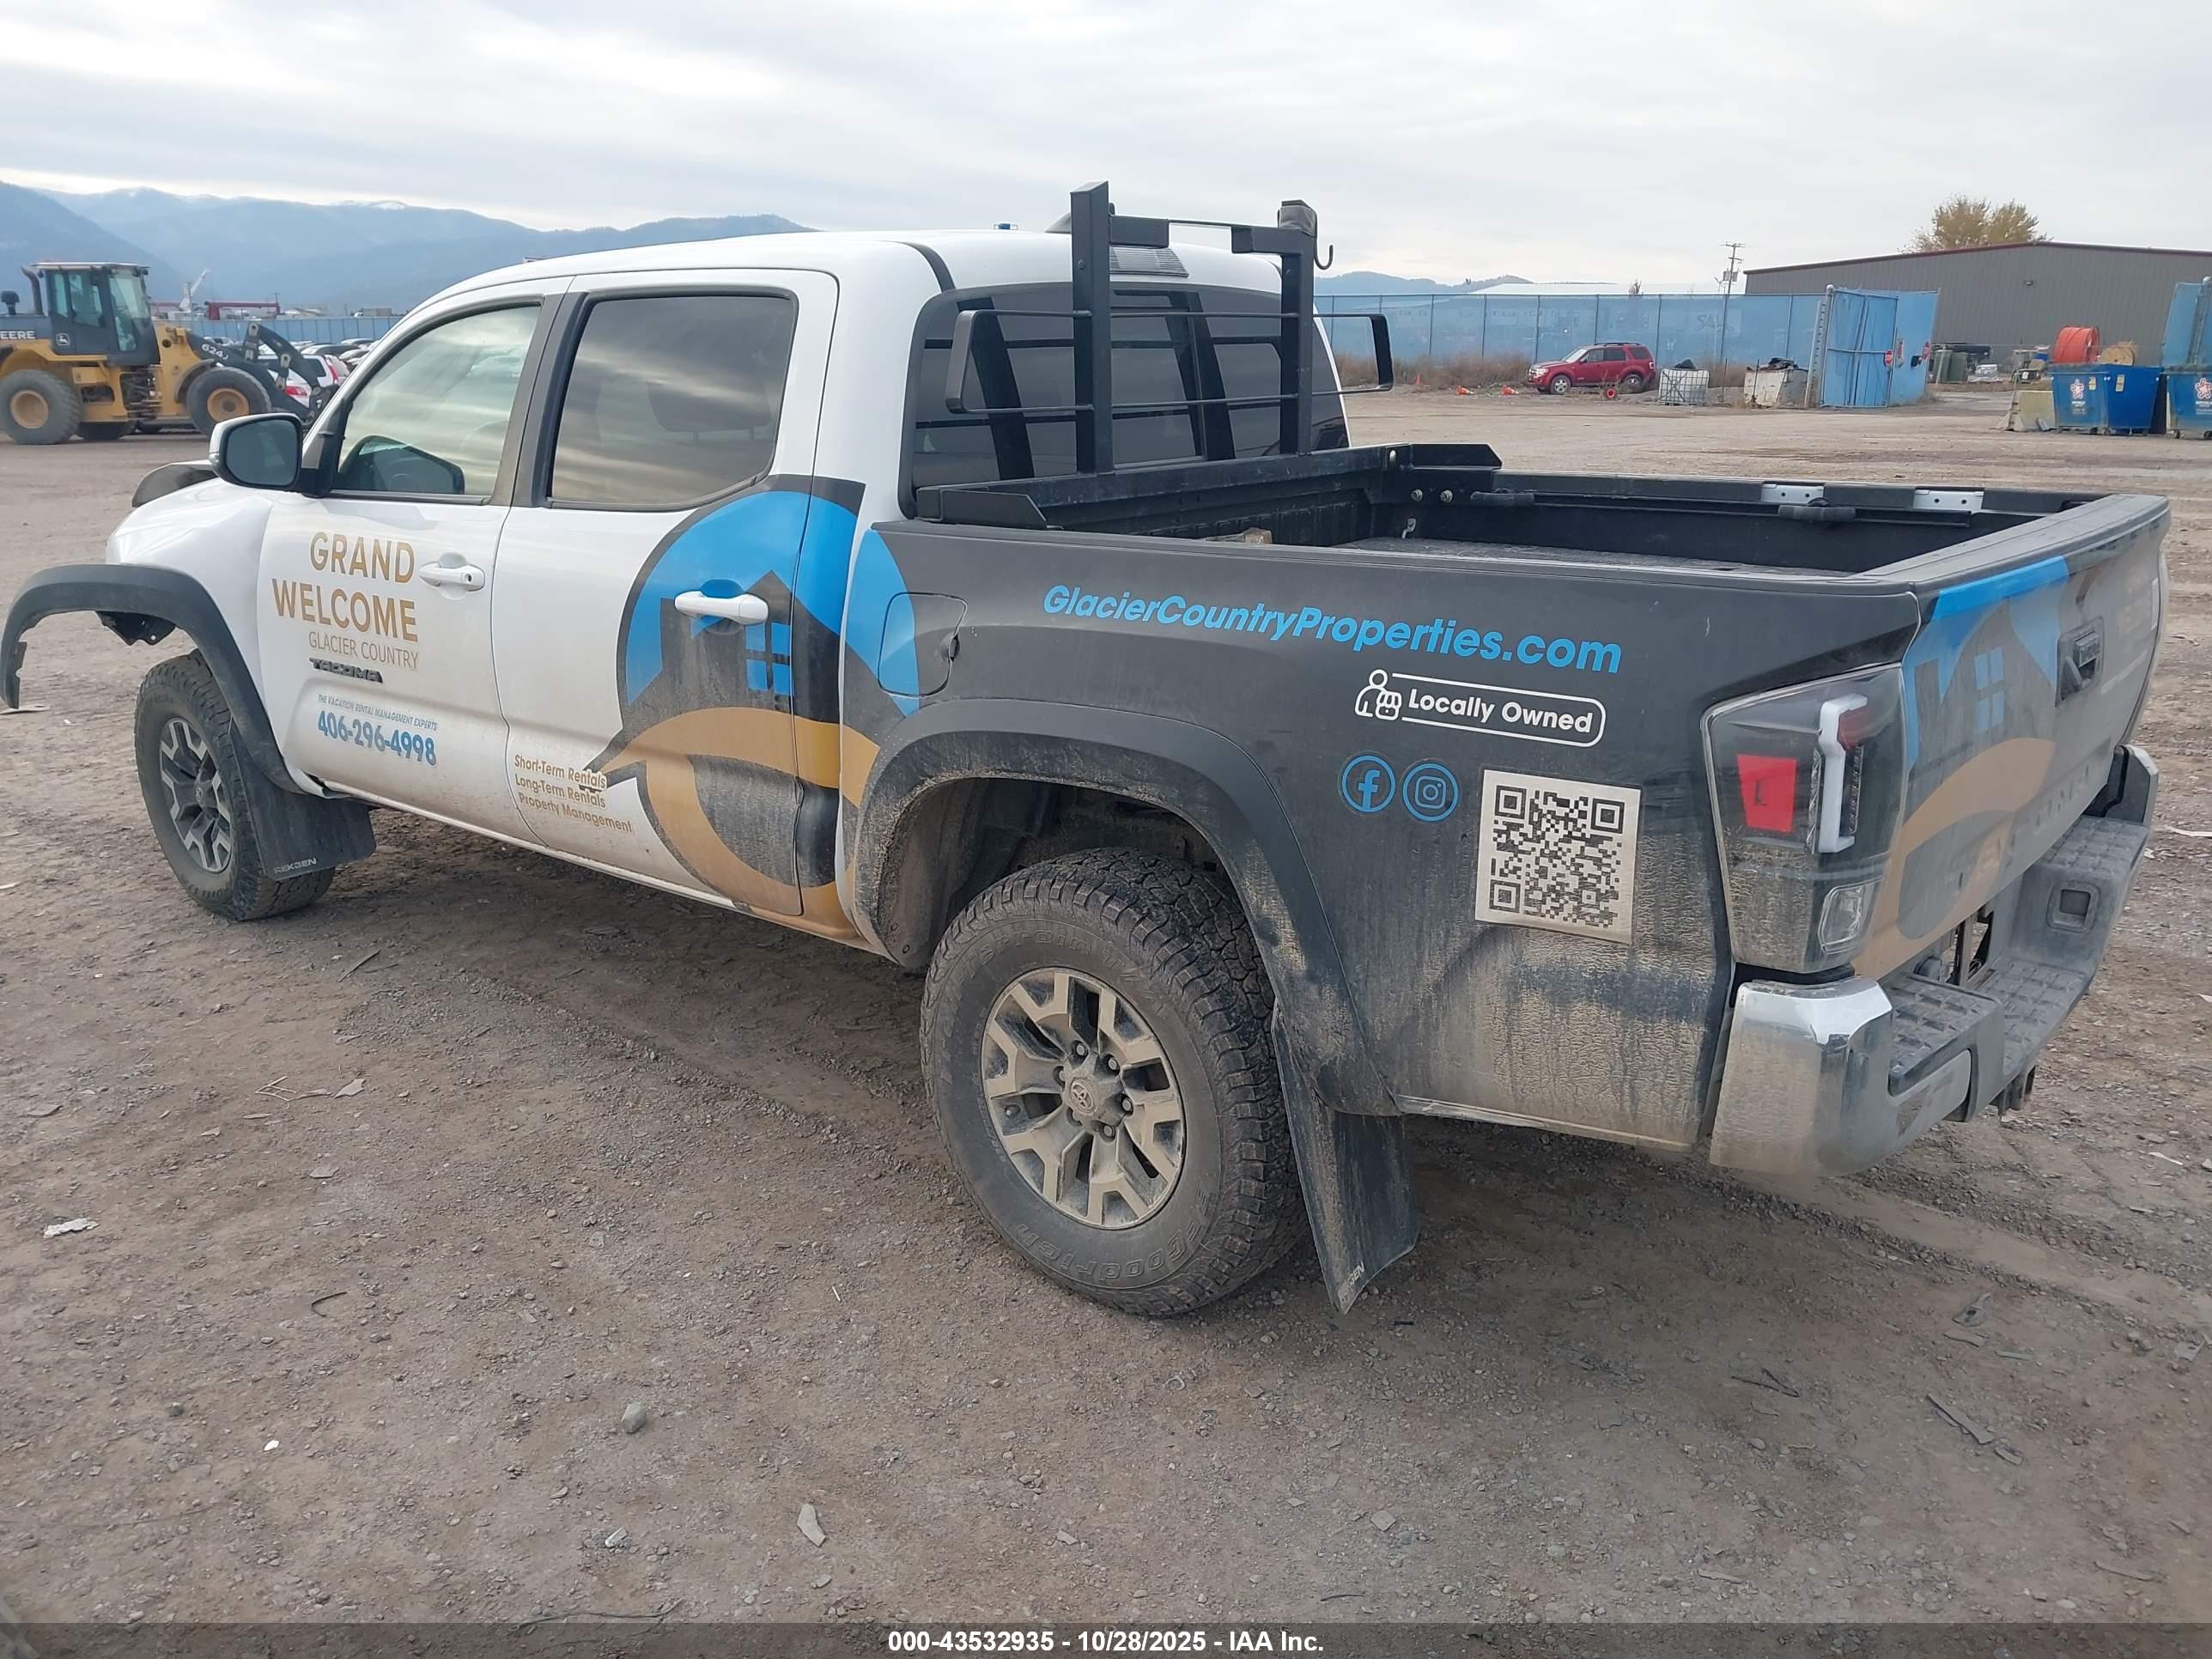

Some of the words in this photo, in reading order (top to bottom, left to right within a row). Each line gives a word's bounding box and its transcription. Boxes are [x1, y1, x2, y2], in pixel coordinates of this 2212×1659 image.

[310, 532, 415, 583] GRAND
[271, 578, 418, 642] WELCOME
[1042, 584, 1624, 675] GlacierCountryProperties.com
[308, 631, 357, 658] GLACIER
[361, 641, 419, 670] COUNTRY
[308, 657, 383, 684] TACOMA
[318, 694, 328, 705] THE
[327, 696, 355, 712] VACATION
[355, 703, 374, 715] RENTAL
[374, 708, 414, 725] MANAGEMENT
[413, 715, 438, 732] EXPERTS
[1408, 689, 1495, 723] Locally
[1502, 702, 1593, 732] Owned
[318, 710, 437, 766] 406-296-4998
[514, 754, 565, 780] Short-Term
[568, 767, 606, 788] Rentals
[515, 773, 565, 798] Long-Term
[567, 786, 606, 808] Rentals
[518, 792, 559, 815] Property
[562, 803, 633, 832] Management
